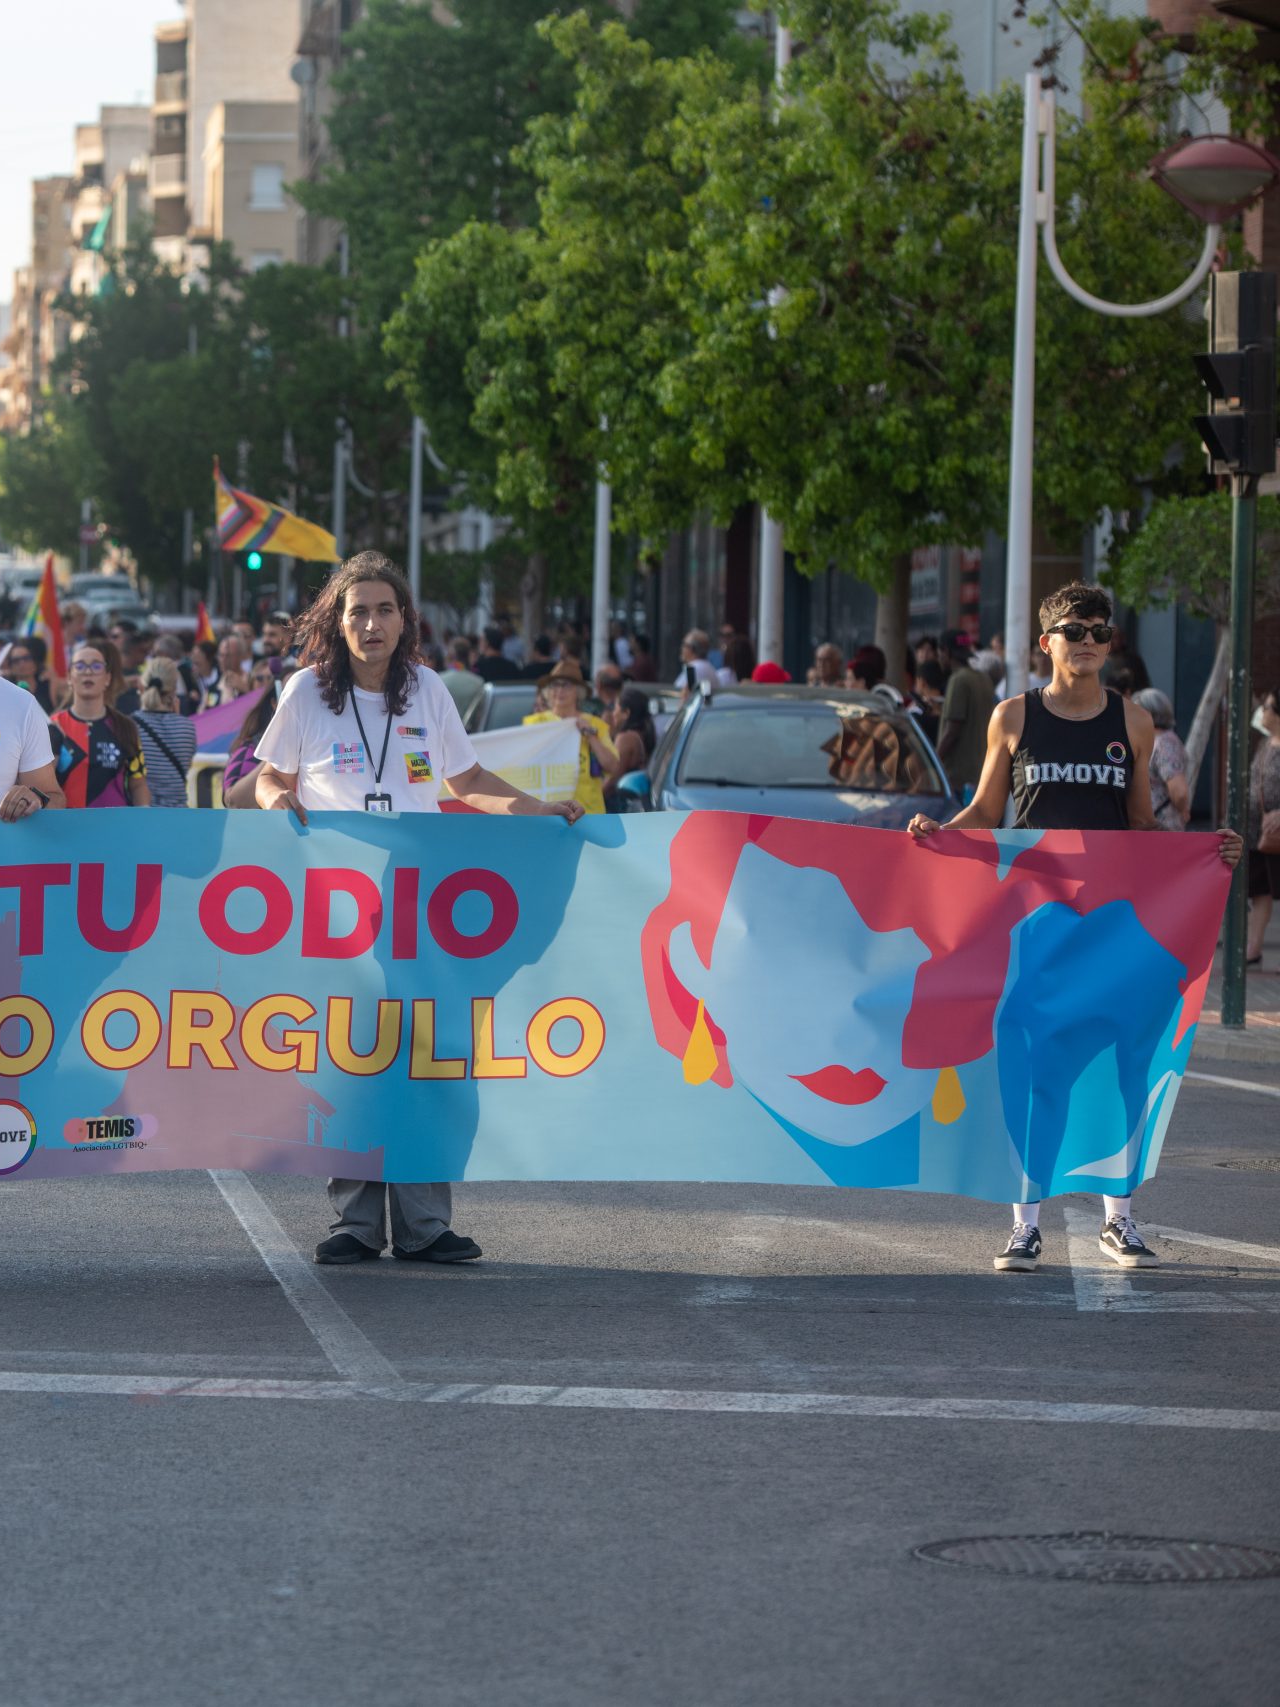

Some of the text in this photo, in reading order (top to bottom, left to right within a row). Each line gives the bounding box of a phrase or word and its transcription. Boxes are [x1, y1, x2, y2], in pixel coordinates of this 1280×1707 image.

[1024, 763, 1126, 788] DIMOVE
[198, 864, 520, 960] ODIO
[81, 989, 607, 1081] ORGULLO
[86, 1118, 135, 1139] TEMIS
[72, 1141, 148, 1153] Asociación LGTBIQ+
